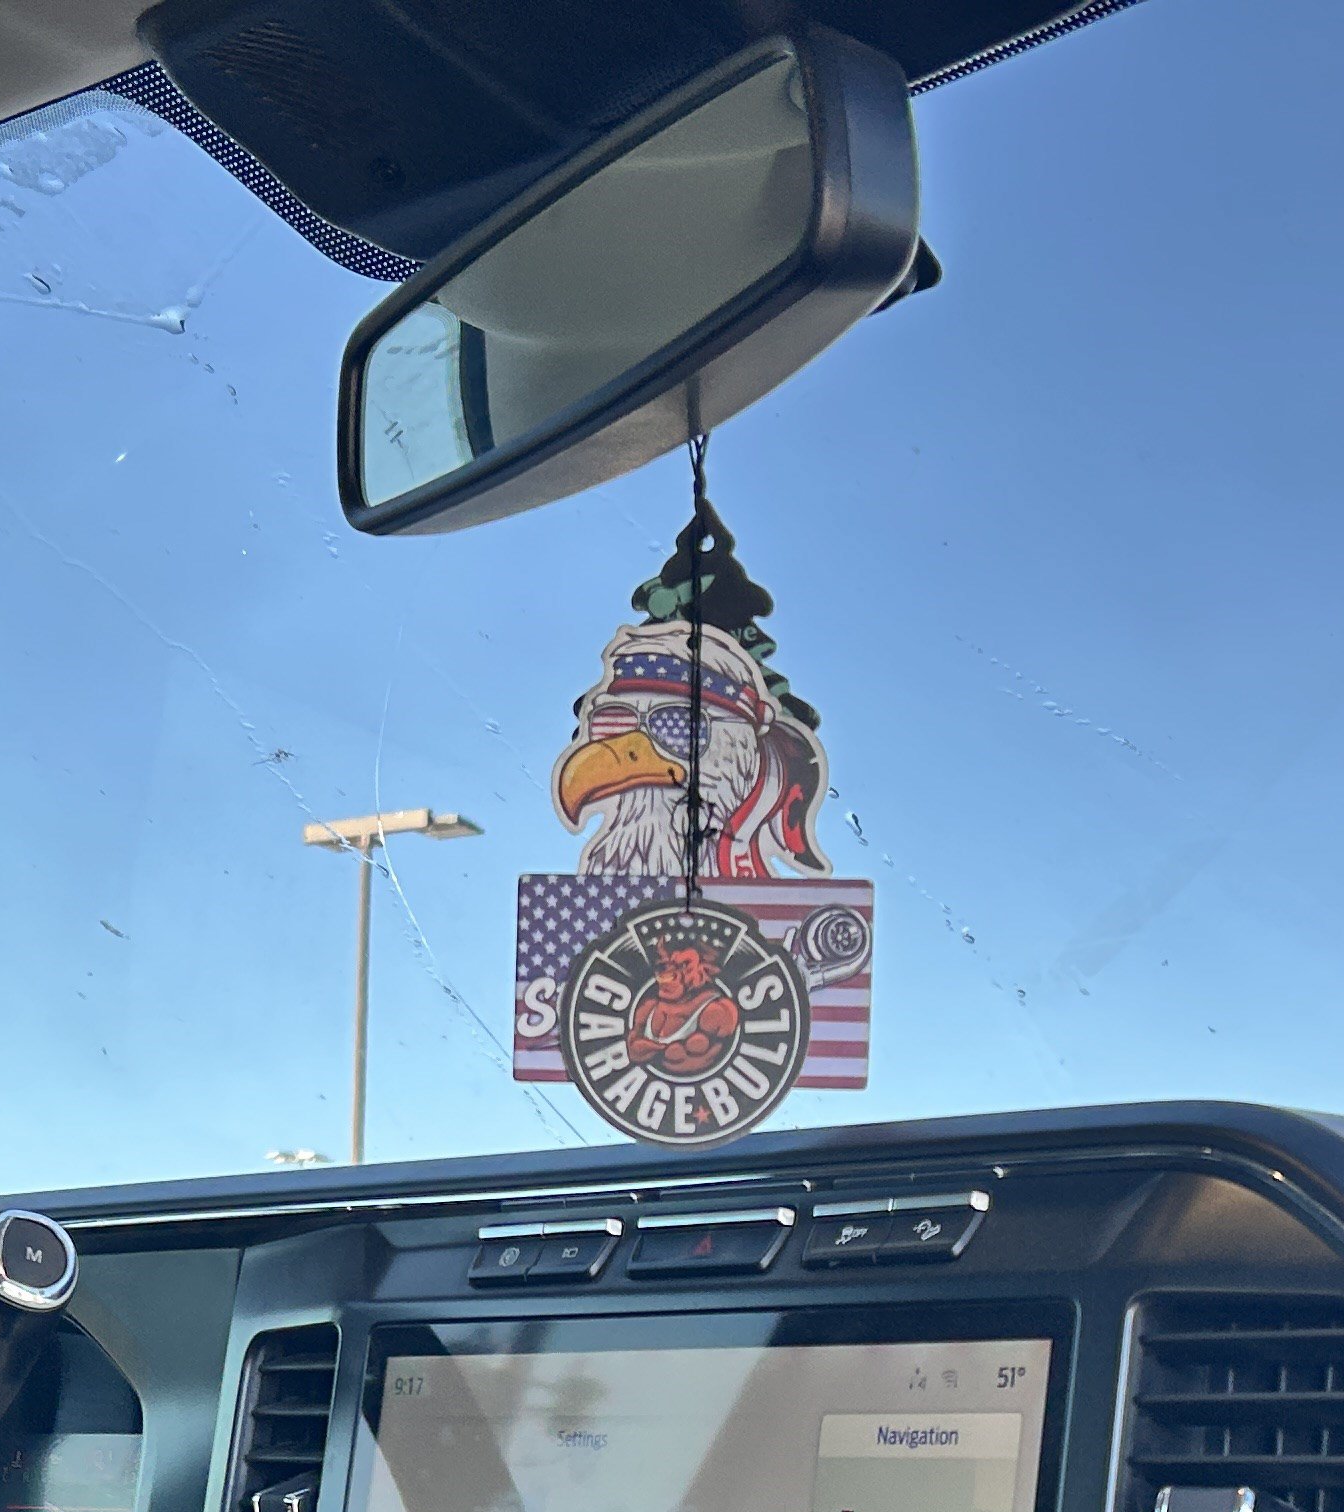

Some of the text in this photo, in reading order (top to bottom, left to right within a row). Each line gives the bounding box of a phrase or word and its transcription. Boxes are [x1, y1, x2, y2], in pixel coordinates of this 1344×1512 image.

[730, 625, 757, 641] ve
[516, 977, 558, 1038] S
[578, 973, 790, 1134] GARAGE BULLS
[26, 1246, 43, 1264] M
[394, 1377, 424, 1395] 9:17
[557, 1430, 608, 1450] Settings
[876, 1426, 959, 1449] Navigation
